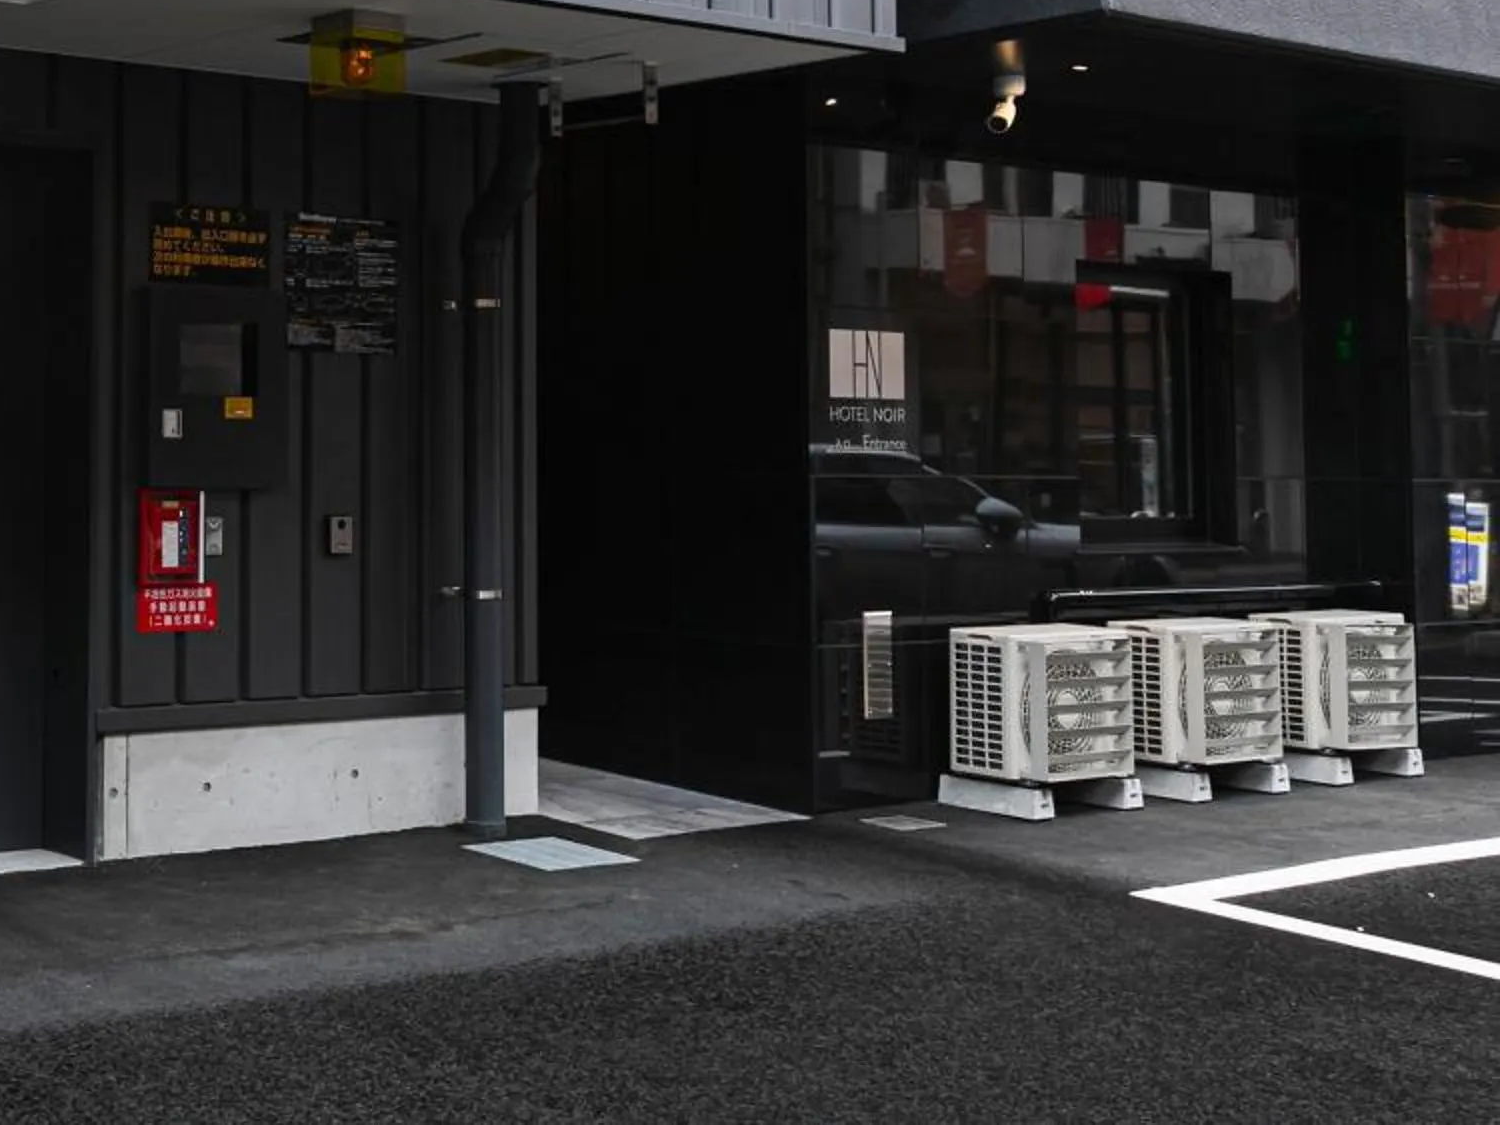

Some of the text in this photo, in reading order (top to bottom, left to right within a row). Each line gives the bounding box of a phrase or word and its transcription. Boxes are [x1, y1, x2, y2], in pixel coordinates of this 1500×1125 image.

[829, 406, 906, 423] HOTEL NOIR
[862, 434, 908, 450] Entrance
